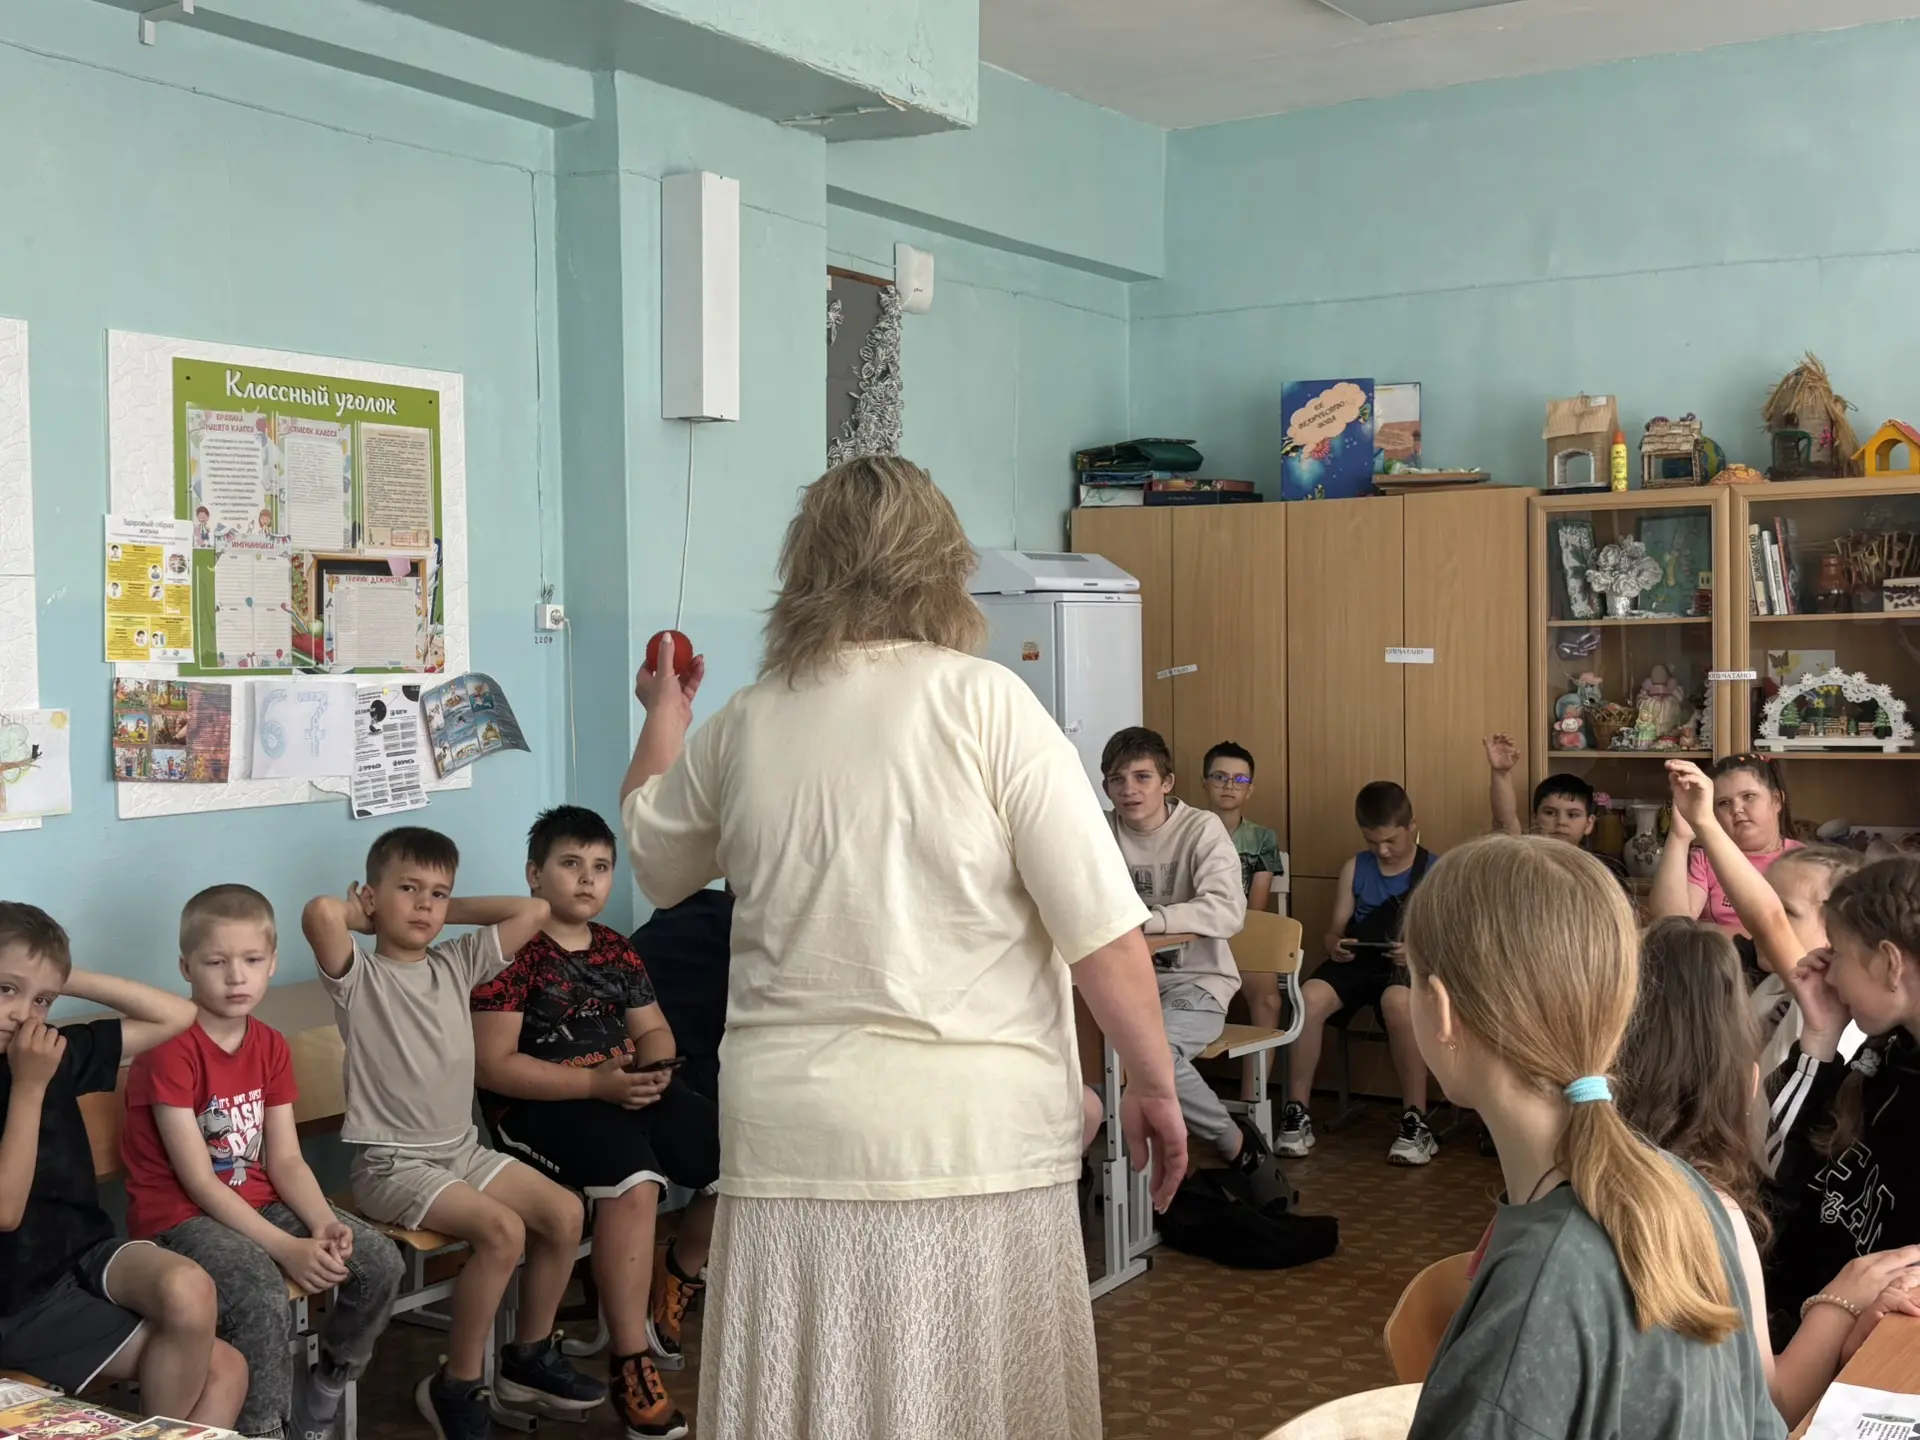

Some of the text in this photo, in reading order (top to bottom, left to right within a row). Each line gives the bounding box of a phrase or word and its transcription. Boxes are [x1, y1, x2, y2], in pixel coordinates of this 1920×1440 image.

[225, 368, 398, 417] Классный уголок
[260, 688, 329, 759] 67
[219, 1088, 261, 1108] IT'S NOT JUST
